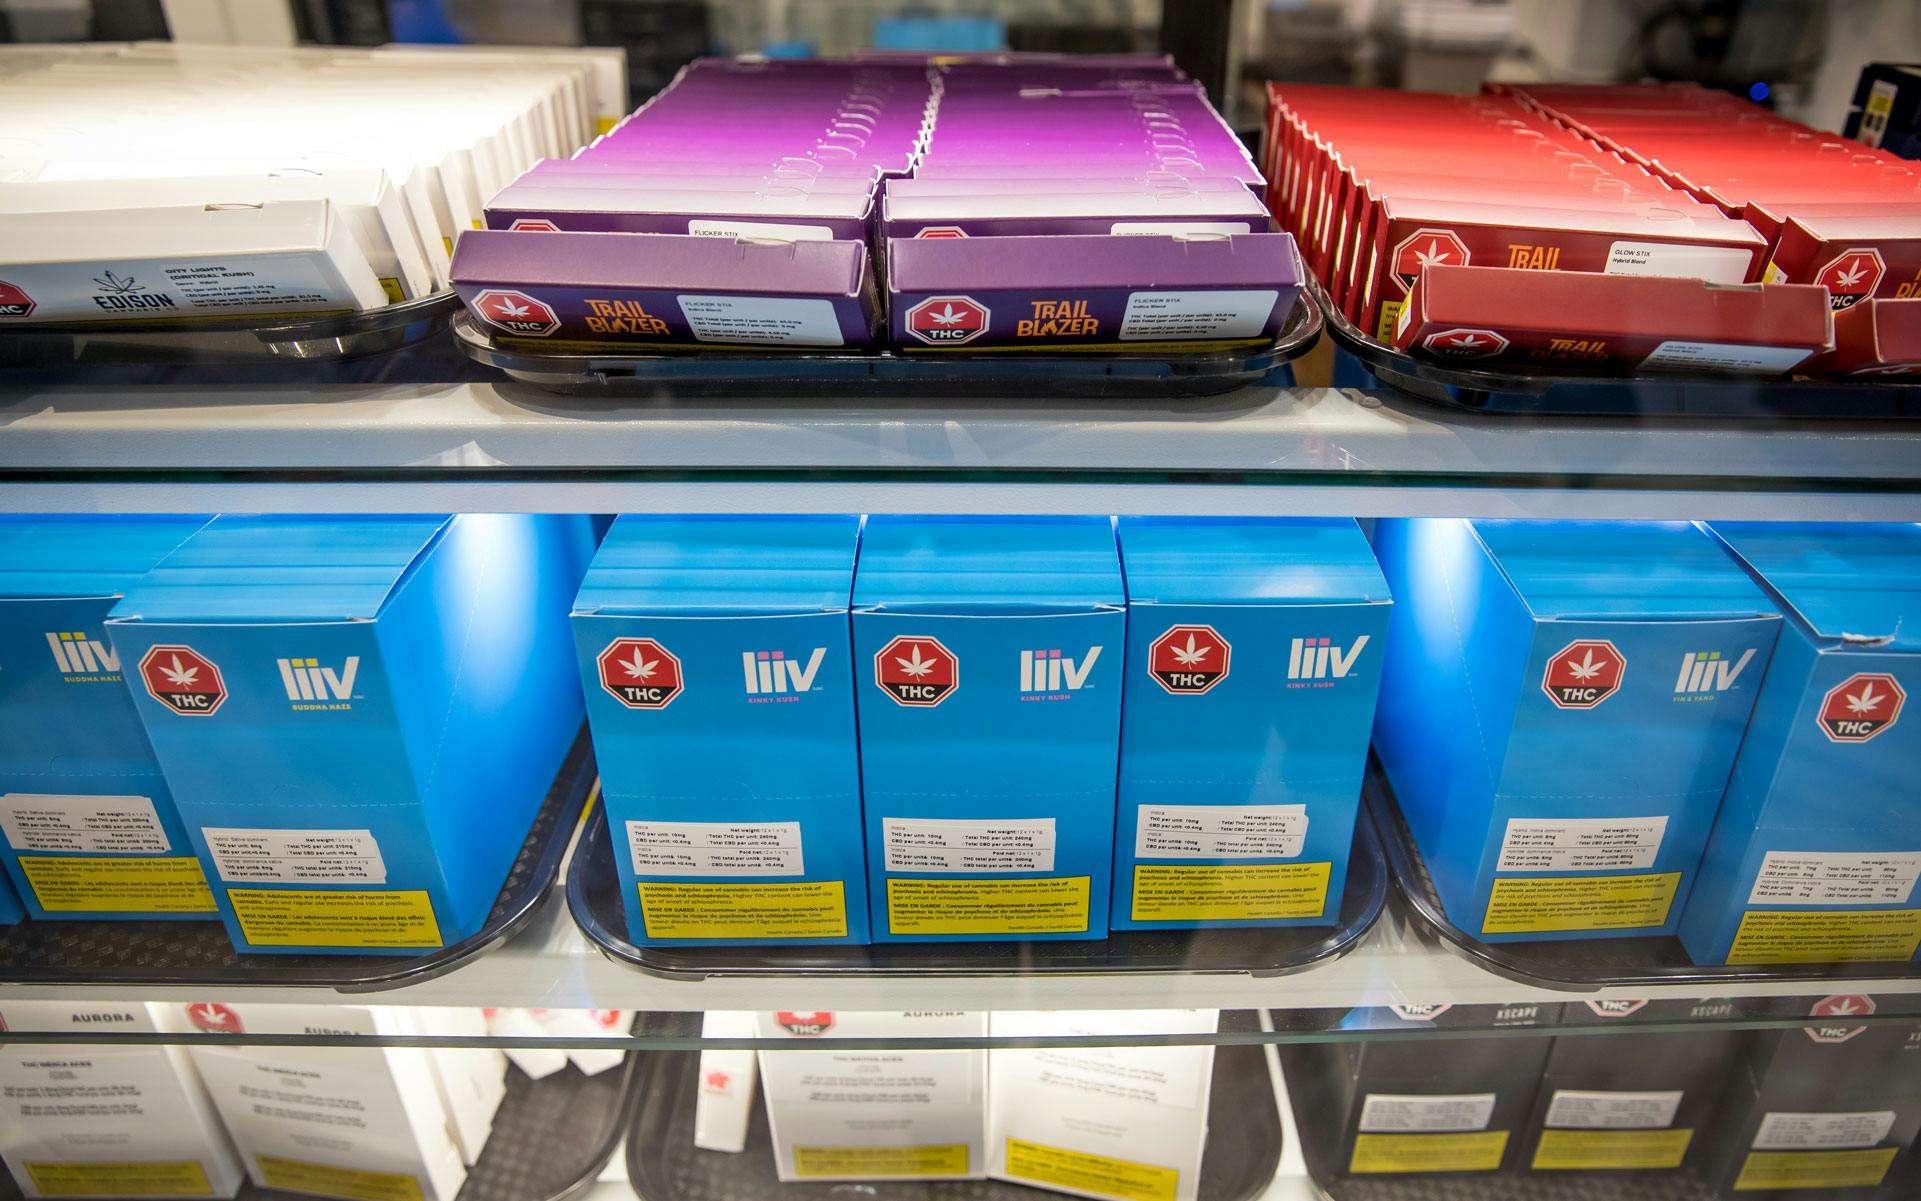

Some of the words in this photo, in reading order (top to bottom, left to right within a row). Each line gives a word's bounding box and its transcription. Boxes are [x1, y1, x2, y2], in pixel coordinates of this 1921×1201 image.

[1508, 244, 1562, 270] TRAIL
[92, 294, 176, 310] EDISON
[584, 299, 653, 319] TRAIL
[1032, 300, 1092, 319] TRAIL
[506, 320, 543, 332] THC
[585, 315, 670, 335] BLAZER
[1018, 317, 1099, 336] BLAZER
[929, 329, 964, 339] THC
[1550, 339, 1606, 354] TRAIL
[1287, 635, 1370, 679] liiv
[742, 647, 827, 694] liiv
[1020, 646, 1104, 692] liiv
[1674, 648, 1758, 693] liiv
[276, 656, 360, 700] liiv
[1170, 673, 1206, 687] THC
[624, 687, 662, 701] THC
[898, 684, 936, 698] THC
[1562, 688, 1598, 700] THC
[172, 694, 209, 708] THC
[1837, 722, 1872, 734] THC
[1405, 1004, 1433, 1014] THC
[1496, 1006, 1538, 1020] XSCAPE
[1602, 1000, 1628, 1012] THC
[72, 1014, 135, 1022] AURORA
[792, 1025, 820, 1034] THC
[1819, 1028, 1848, 1036] THC
